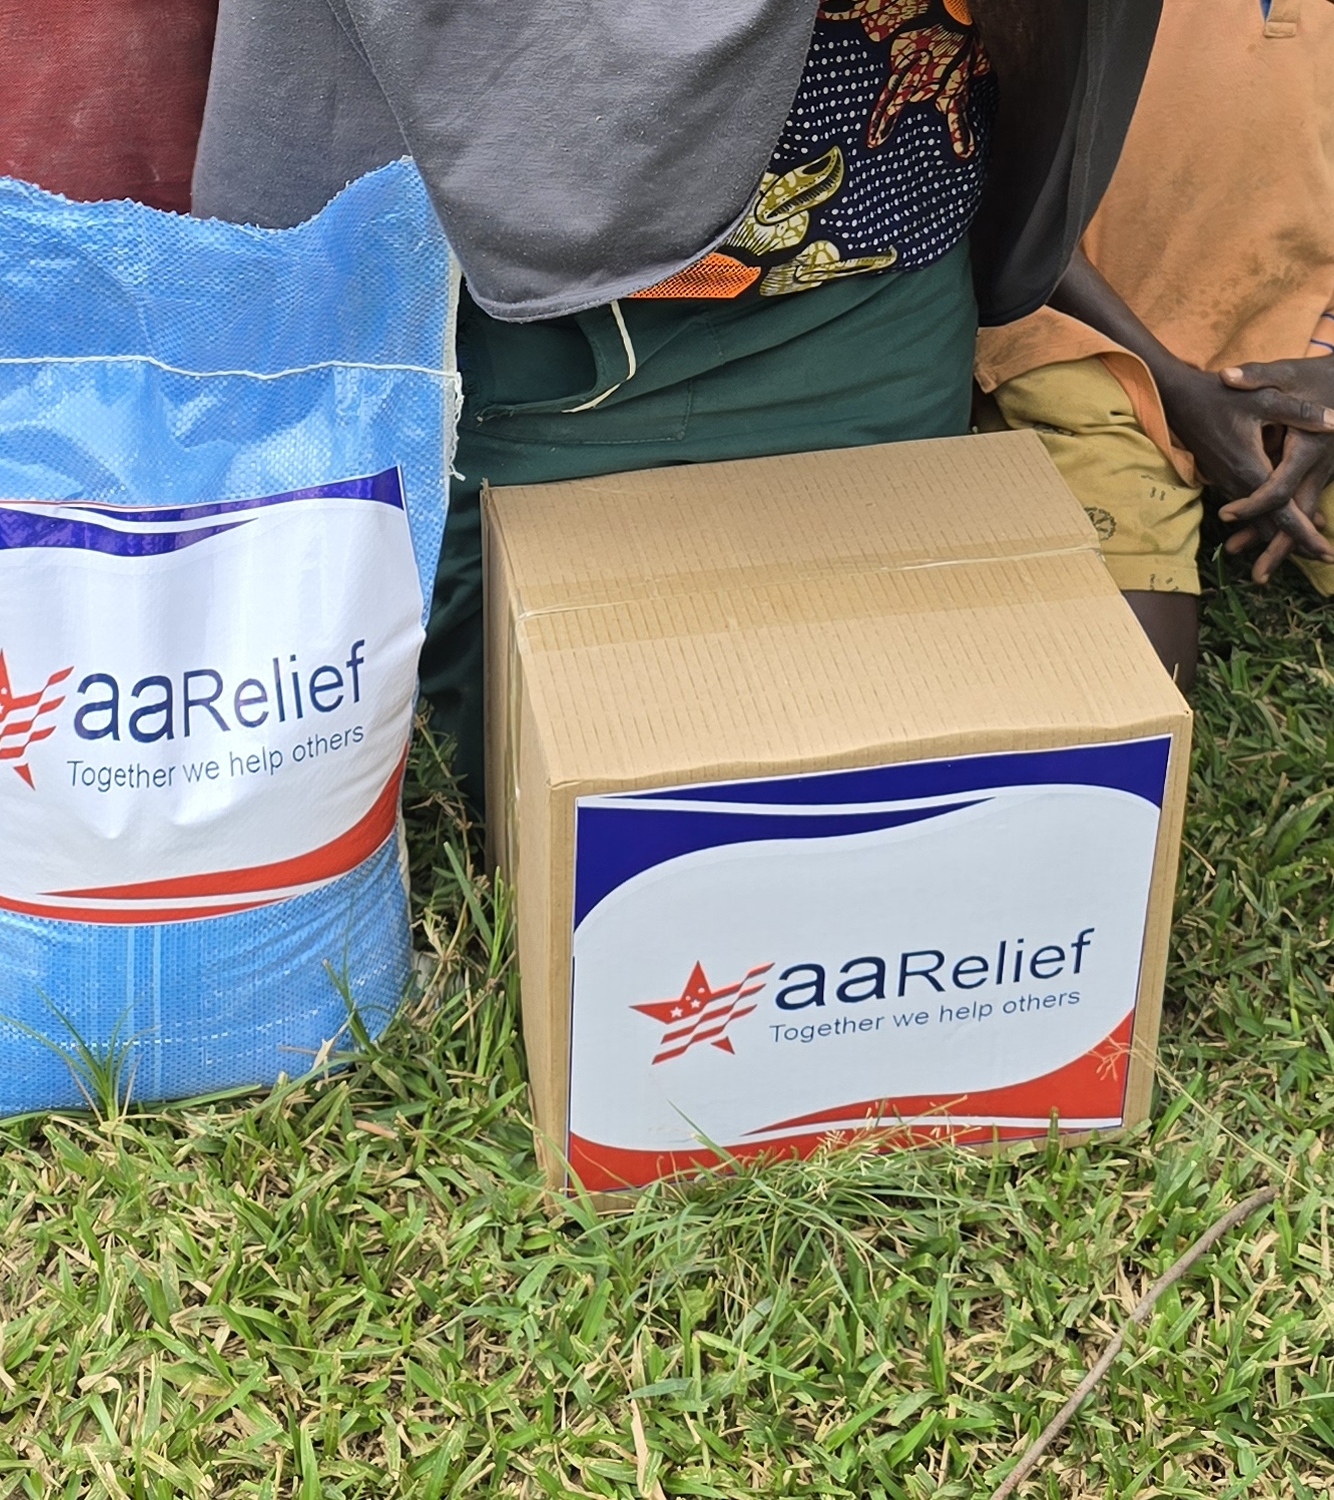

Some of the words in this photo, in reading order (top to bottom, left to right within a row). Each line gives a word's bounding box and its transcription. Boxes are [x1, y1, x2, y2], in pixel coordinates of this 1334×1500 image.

[73, 639, 366, 744] aaRelief
[66, 760, 175, 793] Together
[182, 760, 220, 783] we
[230, 747, 284, 777] help
[292, 725, 364, 763] others
[775, 927, 1095, 1011] aaRelief
[769, 1016, 885, 1044] Together
[892, 1011, 930, 1028] we
[939, 1001, 993, 1023] help
[1002, 991, 1080, 1014] others
